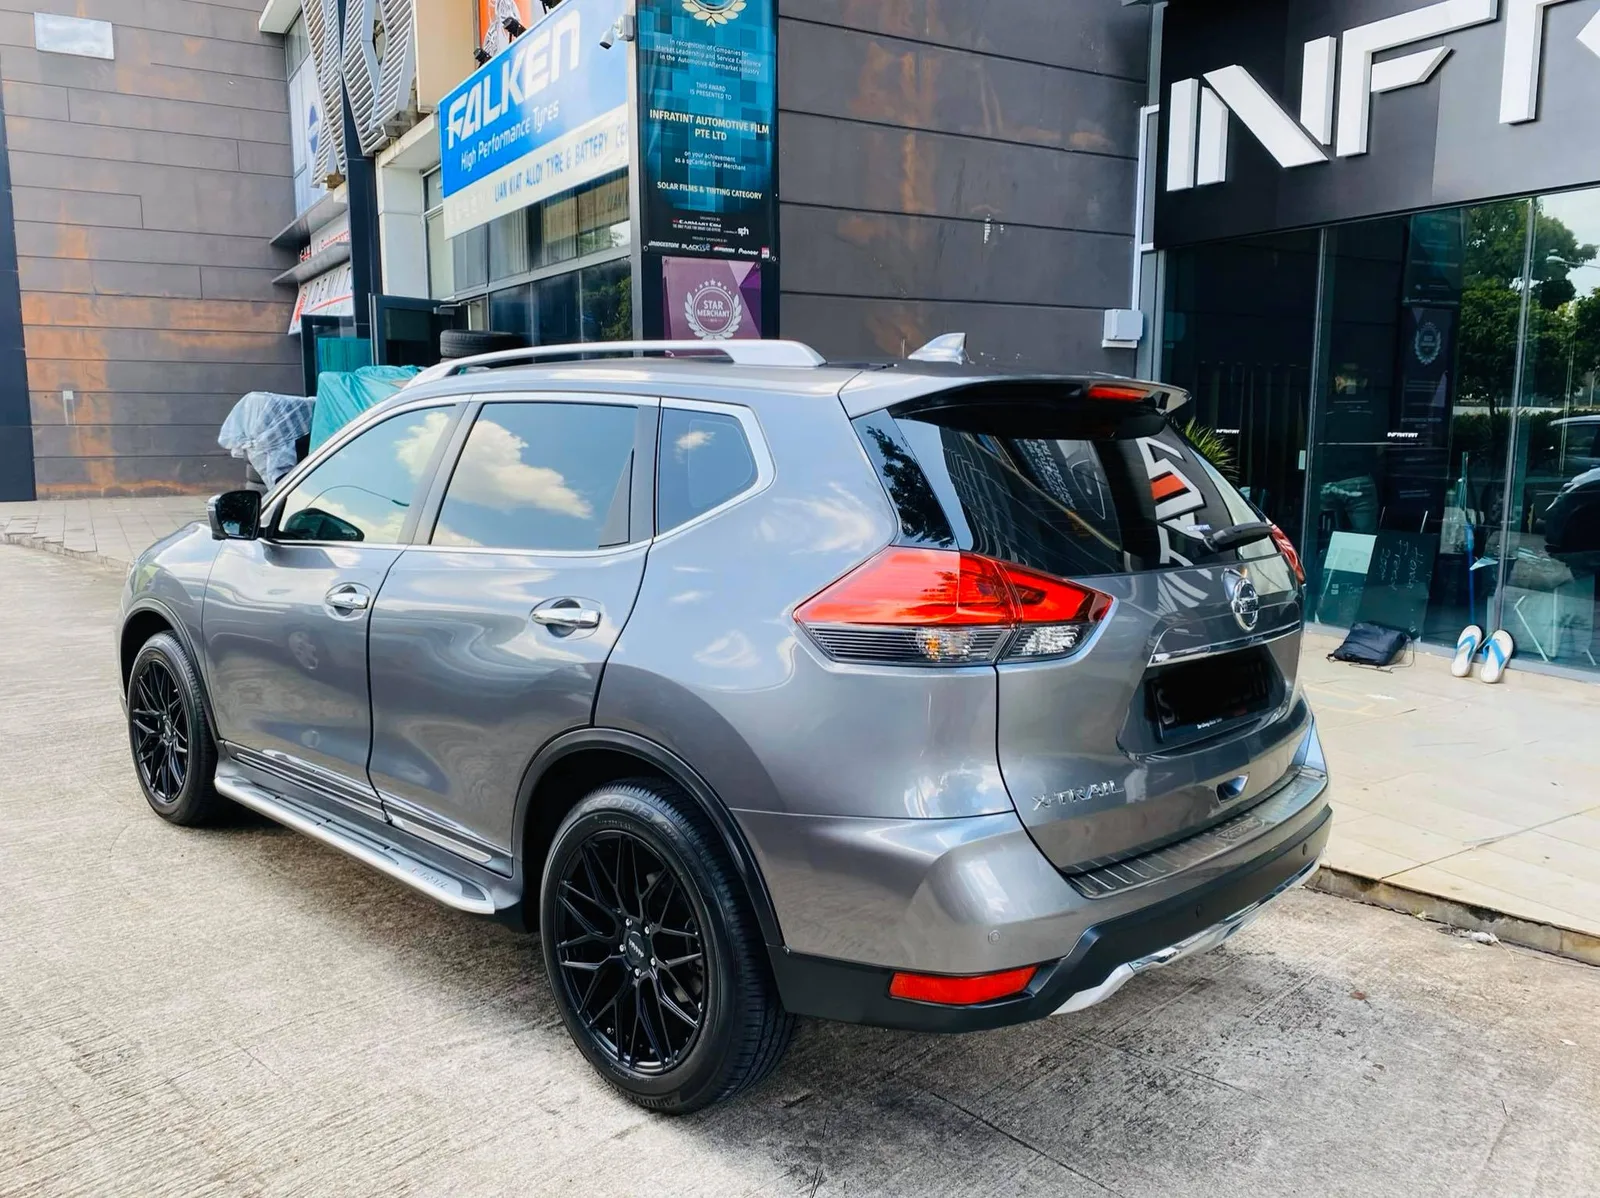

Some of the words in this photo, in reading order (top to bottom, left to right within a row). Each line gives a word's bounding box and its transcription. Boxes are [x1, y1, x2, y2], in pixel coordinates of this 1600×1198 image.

[676, 40, 707, 50] recognition
[713, 46, 741, 56] Companies
[676, 48, 705, 58] Leadership
[716, 55, 735, 63] Service
[735, 58, 762, 68] Excellence
[678, 56, 708, 66] Automotive
[708, 61, 739, 72] Aftermarket
[446, 10, 580, 149] FALKEN
[696, 82, 708, 90] THIS
[708, 84, 726, 92] AWARD
[696, 90, 724, 100] PRESENTED
[650, 109, 694, 124] INFRATINT
[695, 117, 749, 132] AUTOMOTIVE
[750, 122, 770, 134] FILM
[461, 146, 477, 172] High
[478, 119, 531, 159] Performance
[533, 100, 559, 133] Tyres
[694, 128, 710, 139] PTE
[711, 130, 728, 141] LTD
[546, 154, 564, 181] TYRE
[575, 130, 608, 164] BATTERY
[692, 152, 704, 160] your
[704, 153, 736, 162] achievement
[712, 160, 723, 168] Star
[724, 162, 746, 171] Merchant
[656, 181, 678, 190] SOLAR
[679, 183, 698, 192] FILMS
[706, 187, 731, 197] TINTING
[732, 190, 762, 200] CATEGORY
[696, 308, 730, 318] MERCHANT
[703, 300, 724, 310] STAR
[1031, 780, 1125, 812] X-TRAIL
